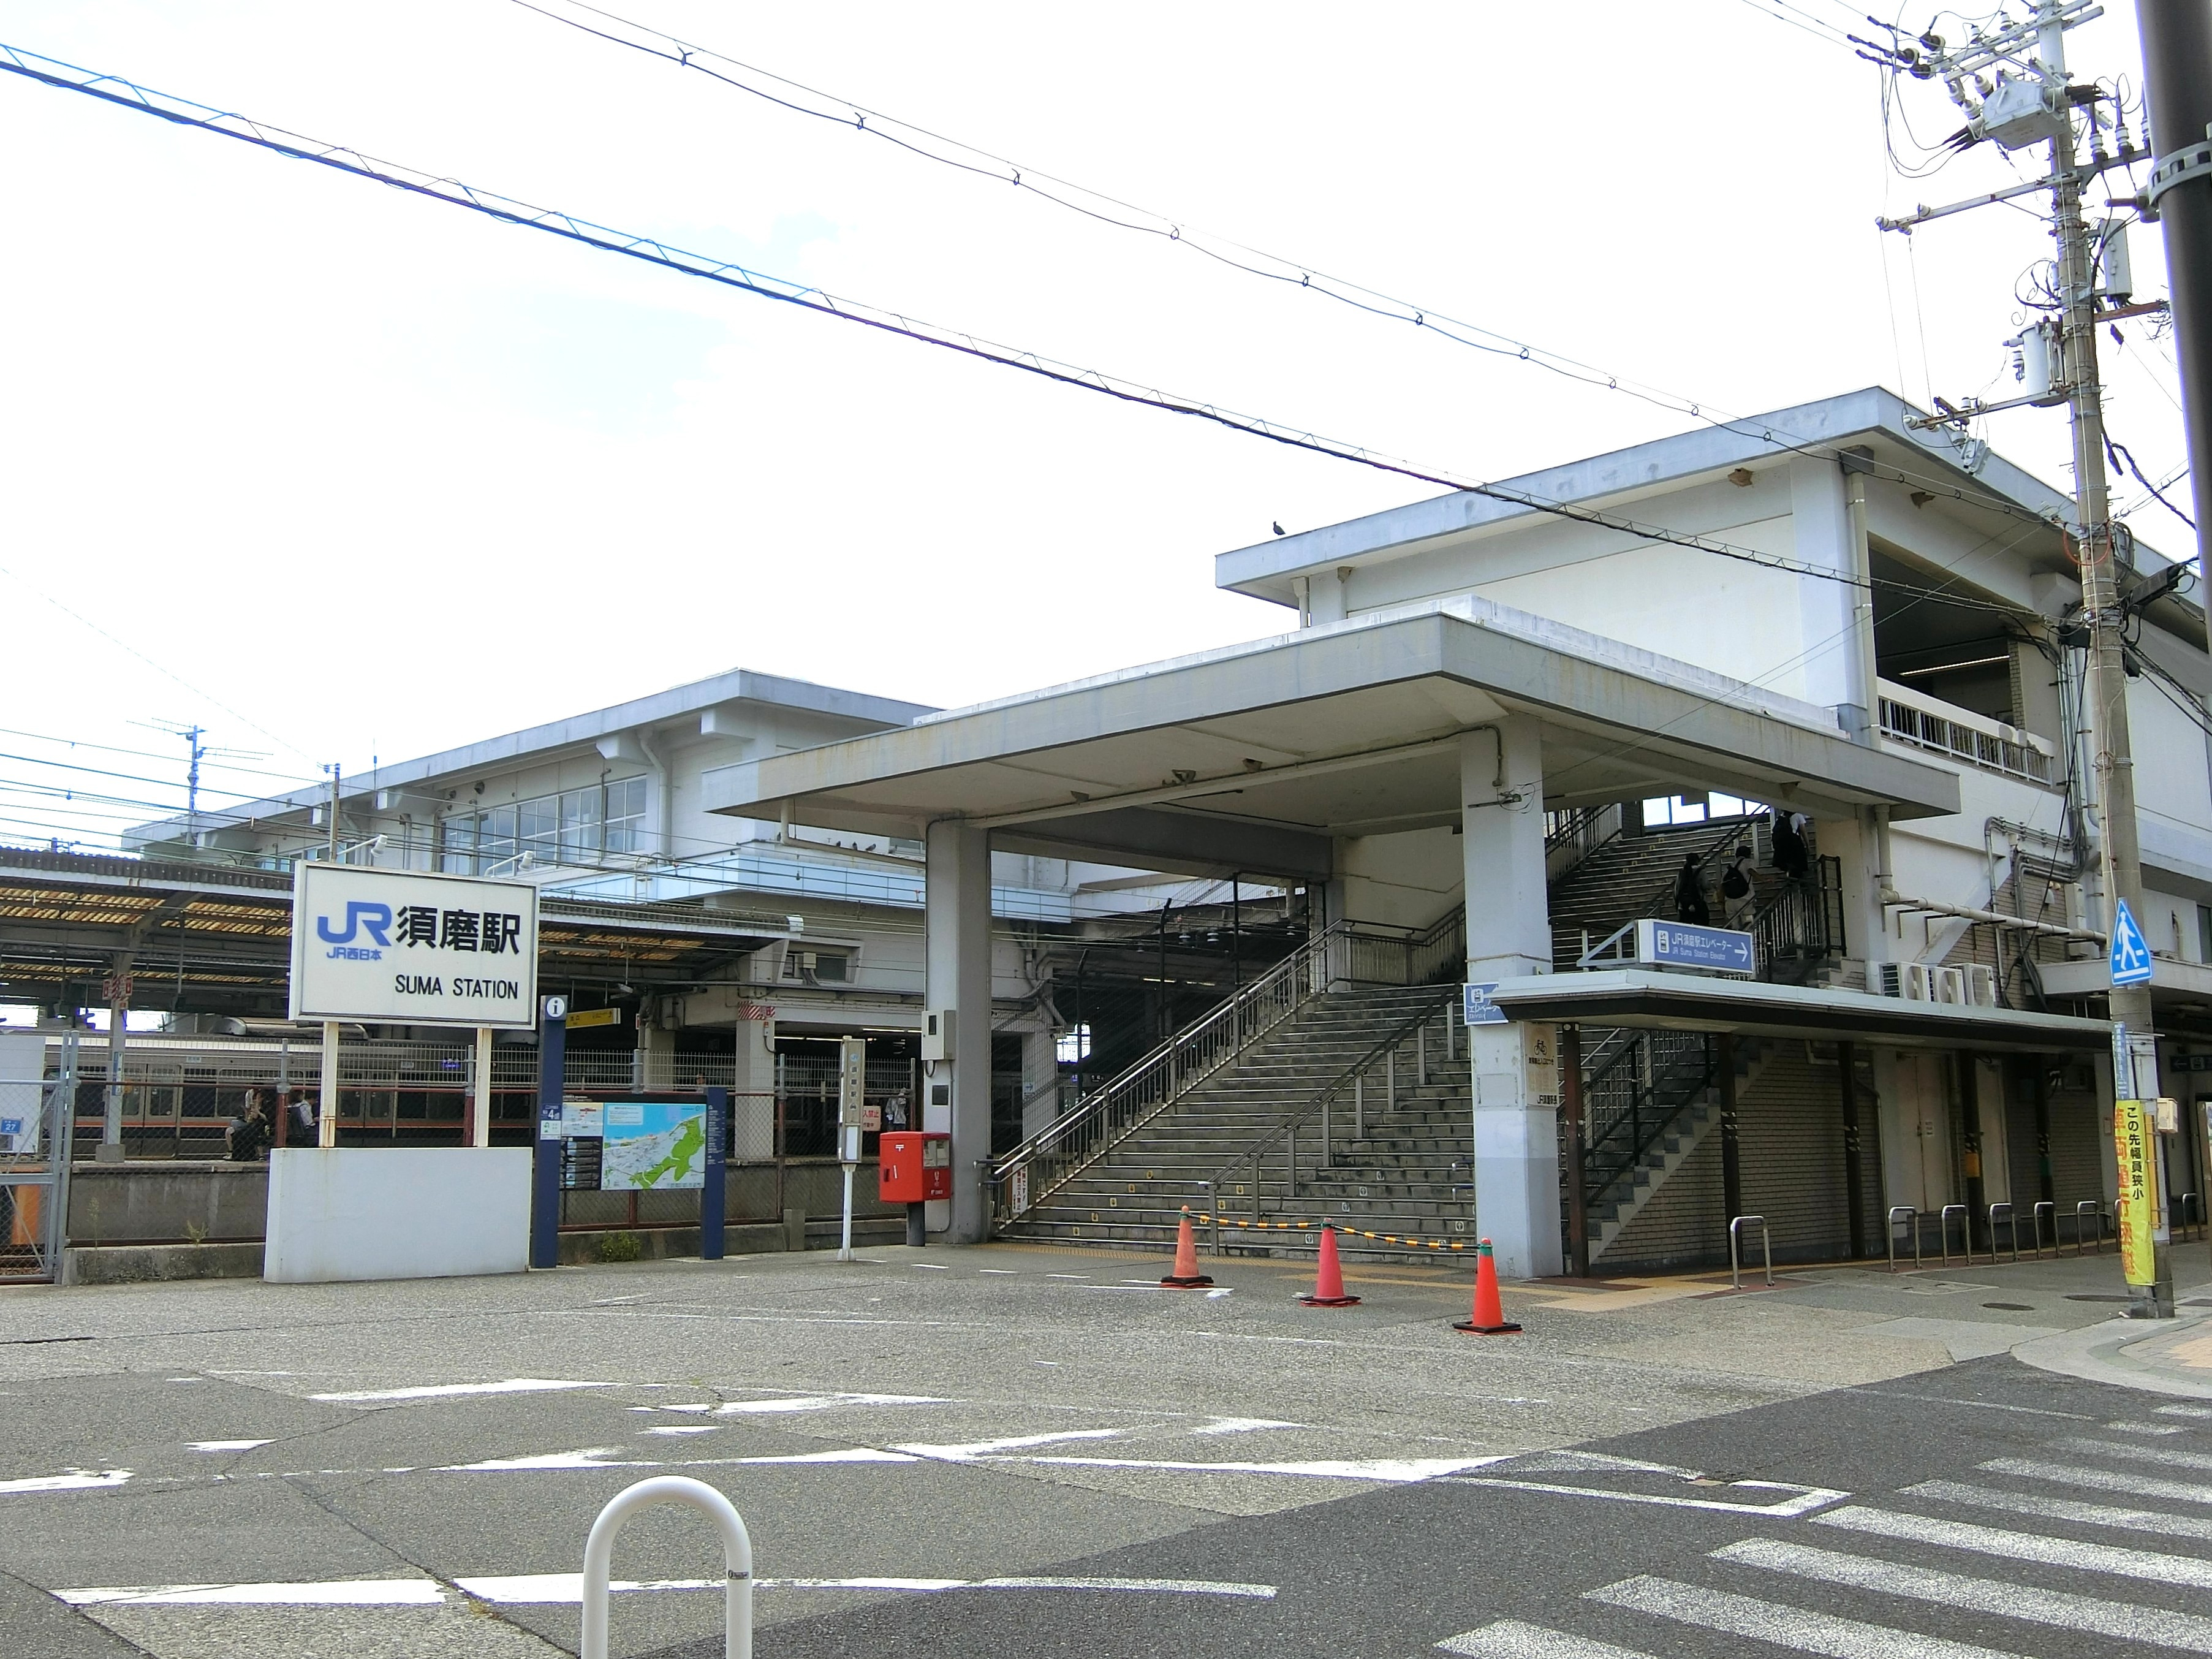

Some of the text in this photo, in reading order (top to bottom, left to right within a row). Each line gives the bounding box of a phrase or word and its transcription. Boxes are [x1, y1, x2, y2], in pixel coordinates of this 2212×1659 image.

[317, 901, 392, 946] JR
[396, 906, 520, 954] 須磨駅
[327, 947, 382, 960] JR西日本
[1680, 947, 1692, 957] Suma
[1694, 949, 1708, 959] Station
[395, 974, 518, 999] SUMA STATION
[2127, 1107, 2145, 1200] この先幅員狭小
